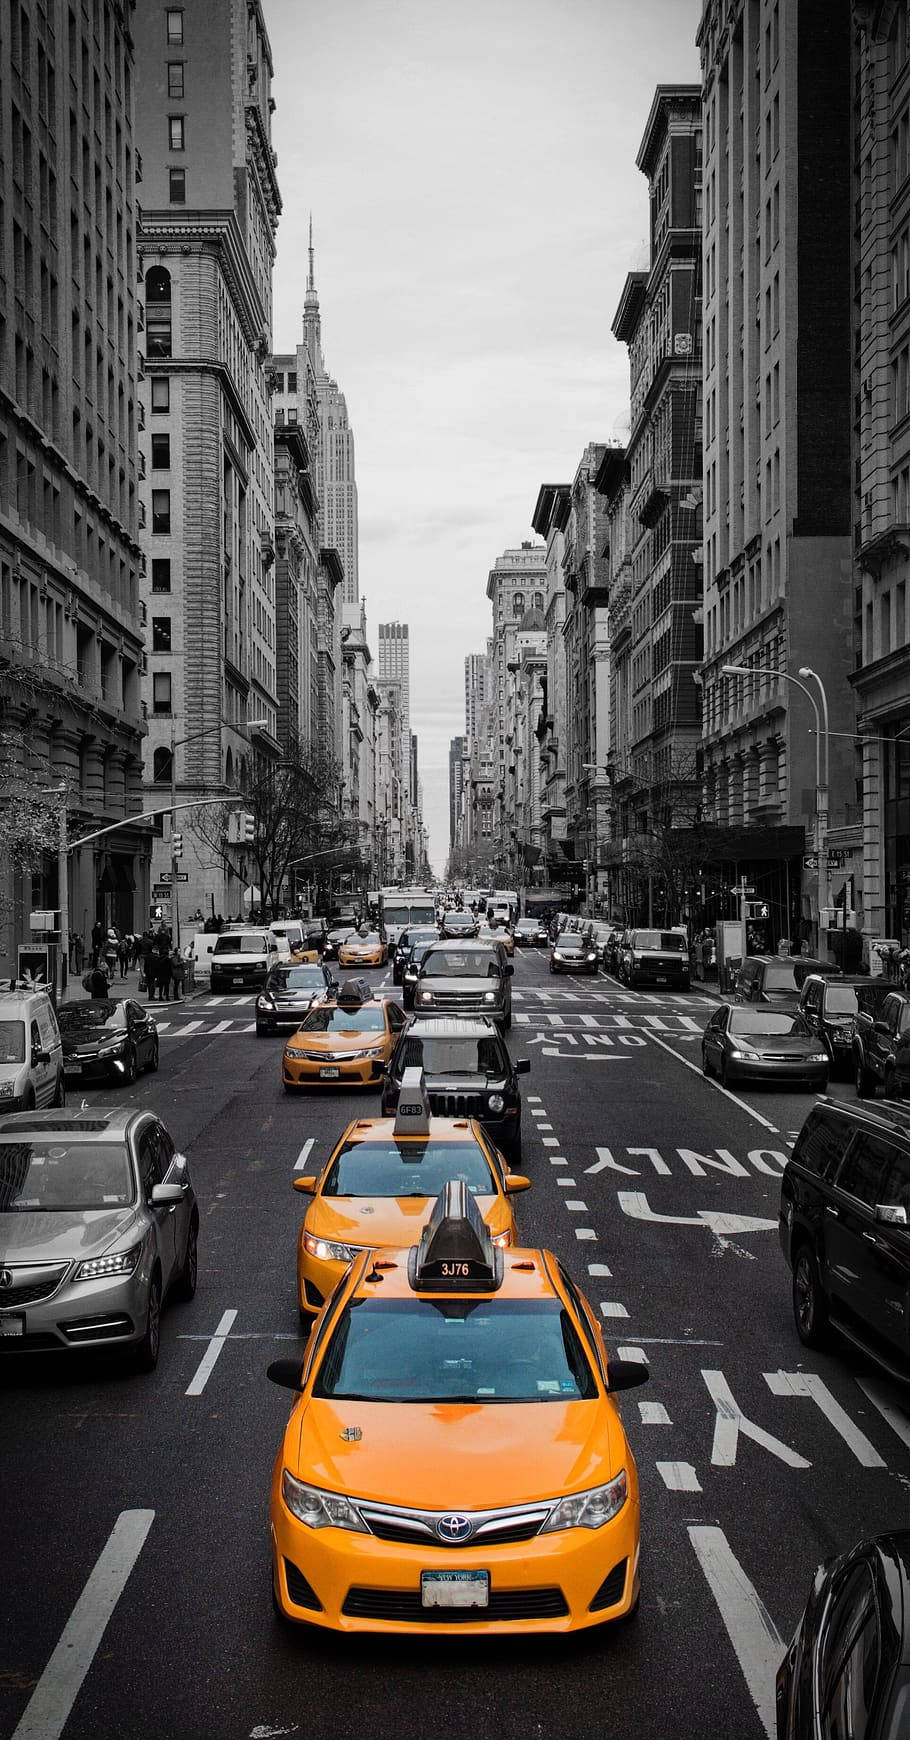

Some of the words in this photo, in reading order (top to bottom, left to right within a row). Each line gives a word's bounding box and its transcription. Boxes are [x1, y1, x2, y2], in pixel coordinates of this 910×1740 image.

[526, 1032, 648, 1047] ONLY
[400, 1105, 422, 1114] 6F83
[583, 1147, 789, 1177] ONLY
[441, 1263, 469, 1276] 3J76
